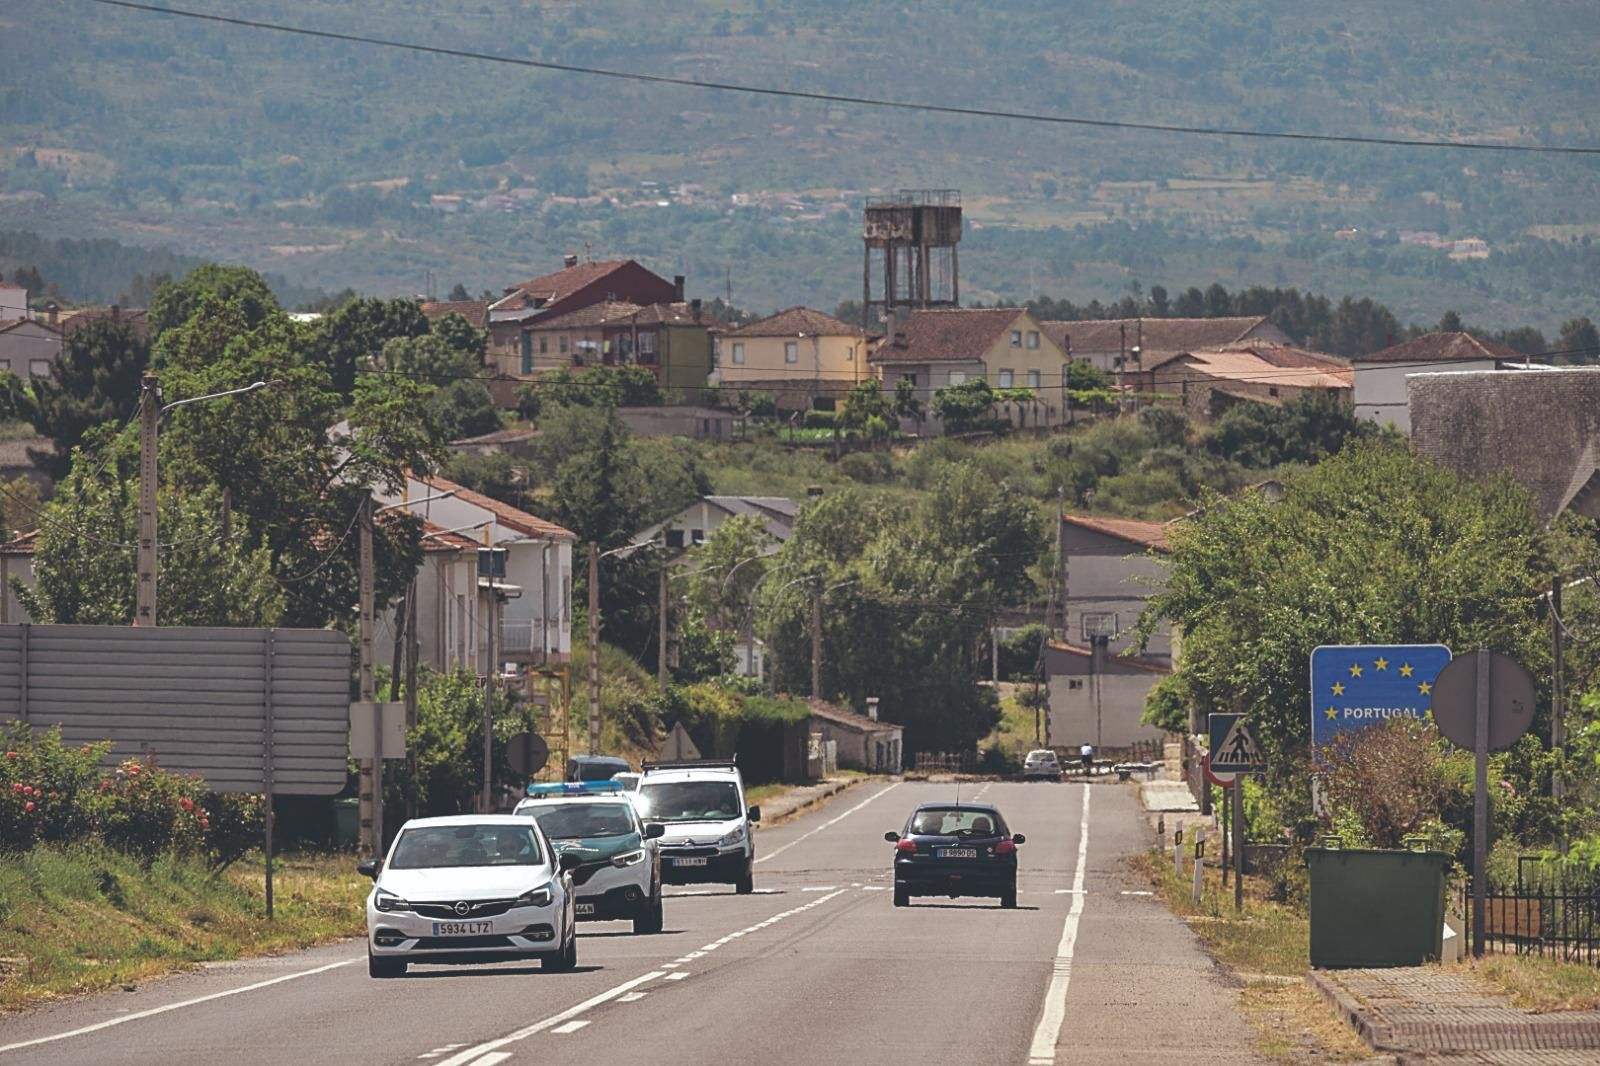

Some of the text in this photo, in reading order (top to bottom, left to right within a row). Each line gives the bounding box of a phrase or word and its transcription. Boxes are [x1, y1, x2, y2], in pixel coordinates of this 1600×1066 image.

[1343, 707, 1420, 719] PORTUGAL
[440, 921, 489, 935] 5934 LTZ
